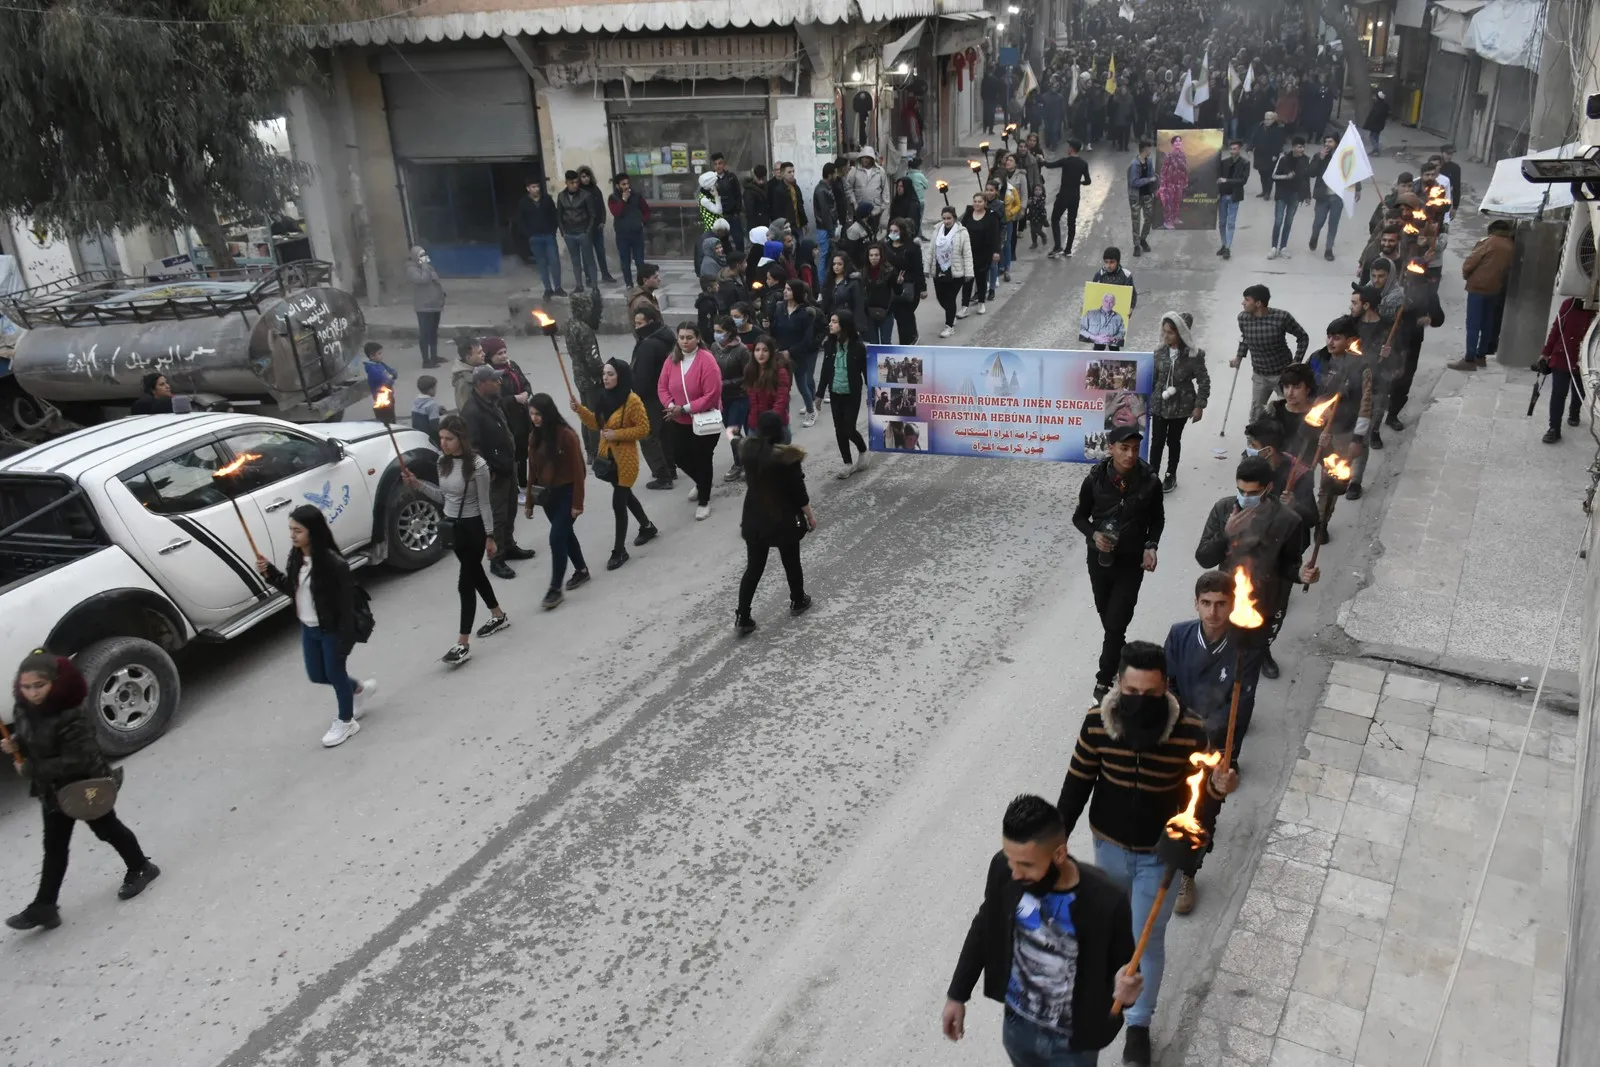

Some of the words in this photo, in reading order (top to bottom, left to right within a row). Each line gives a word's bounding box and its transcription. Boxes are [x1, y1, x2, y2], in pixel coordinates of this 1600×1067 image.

[919, 394, 974, 405] PARASTINA
[977, 396, 1019, 407] RÛMETA
[1022, 396, 1052, 408] JINÊN
[1055, 398, 1103, 411] ŞENGALÊ
[931, 410, 987, 421] PARASTINA
[990, 411, 1032, 423] HEBÛNA
[1035, 415, 1064, 425] JINAN
[1067, 416, 1082, 426] NE
[1014, 431, 1038, 440] كرامة
[1039, 433, 1060, 442] صون
[996, 443, 1022, 453] كرامة
[1023, 445, 1044, 454] صون
